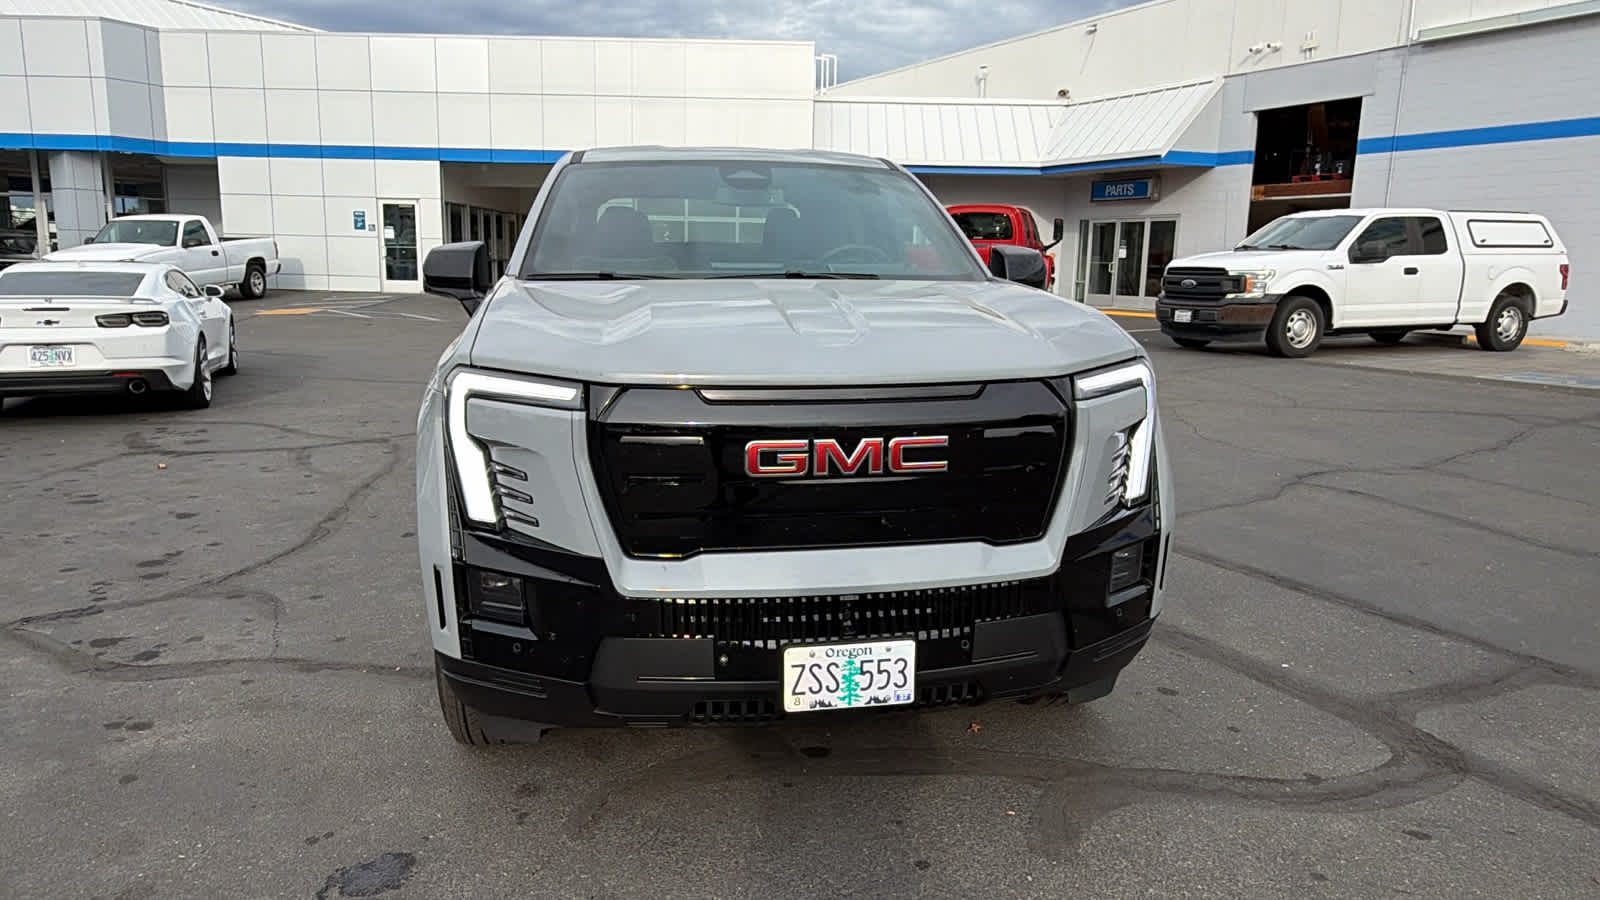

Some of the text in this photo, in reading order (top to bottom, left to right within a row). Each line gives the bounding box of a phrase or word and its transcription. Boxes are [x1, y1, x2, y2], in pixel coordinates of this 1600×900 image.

[1105, 184, 1135, 196] PARTS
[744, 435, 949, 477] GMC
[825, 647, 873, 659] Oregon
[791, 658, 908, 696] ZSS 553
